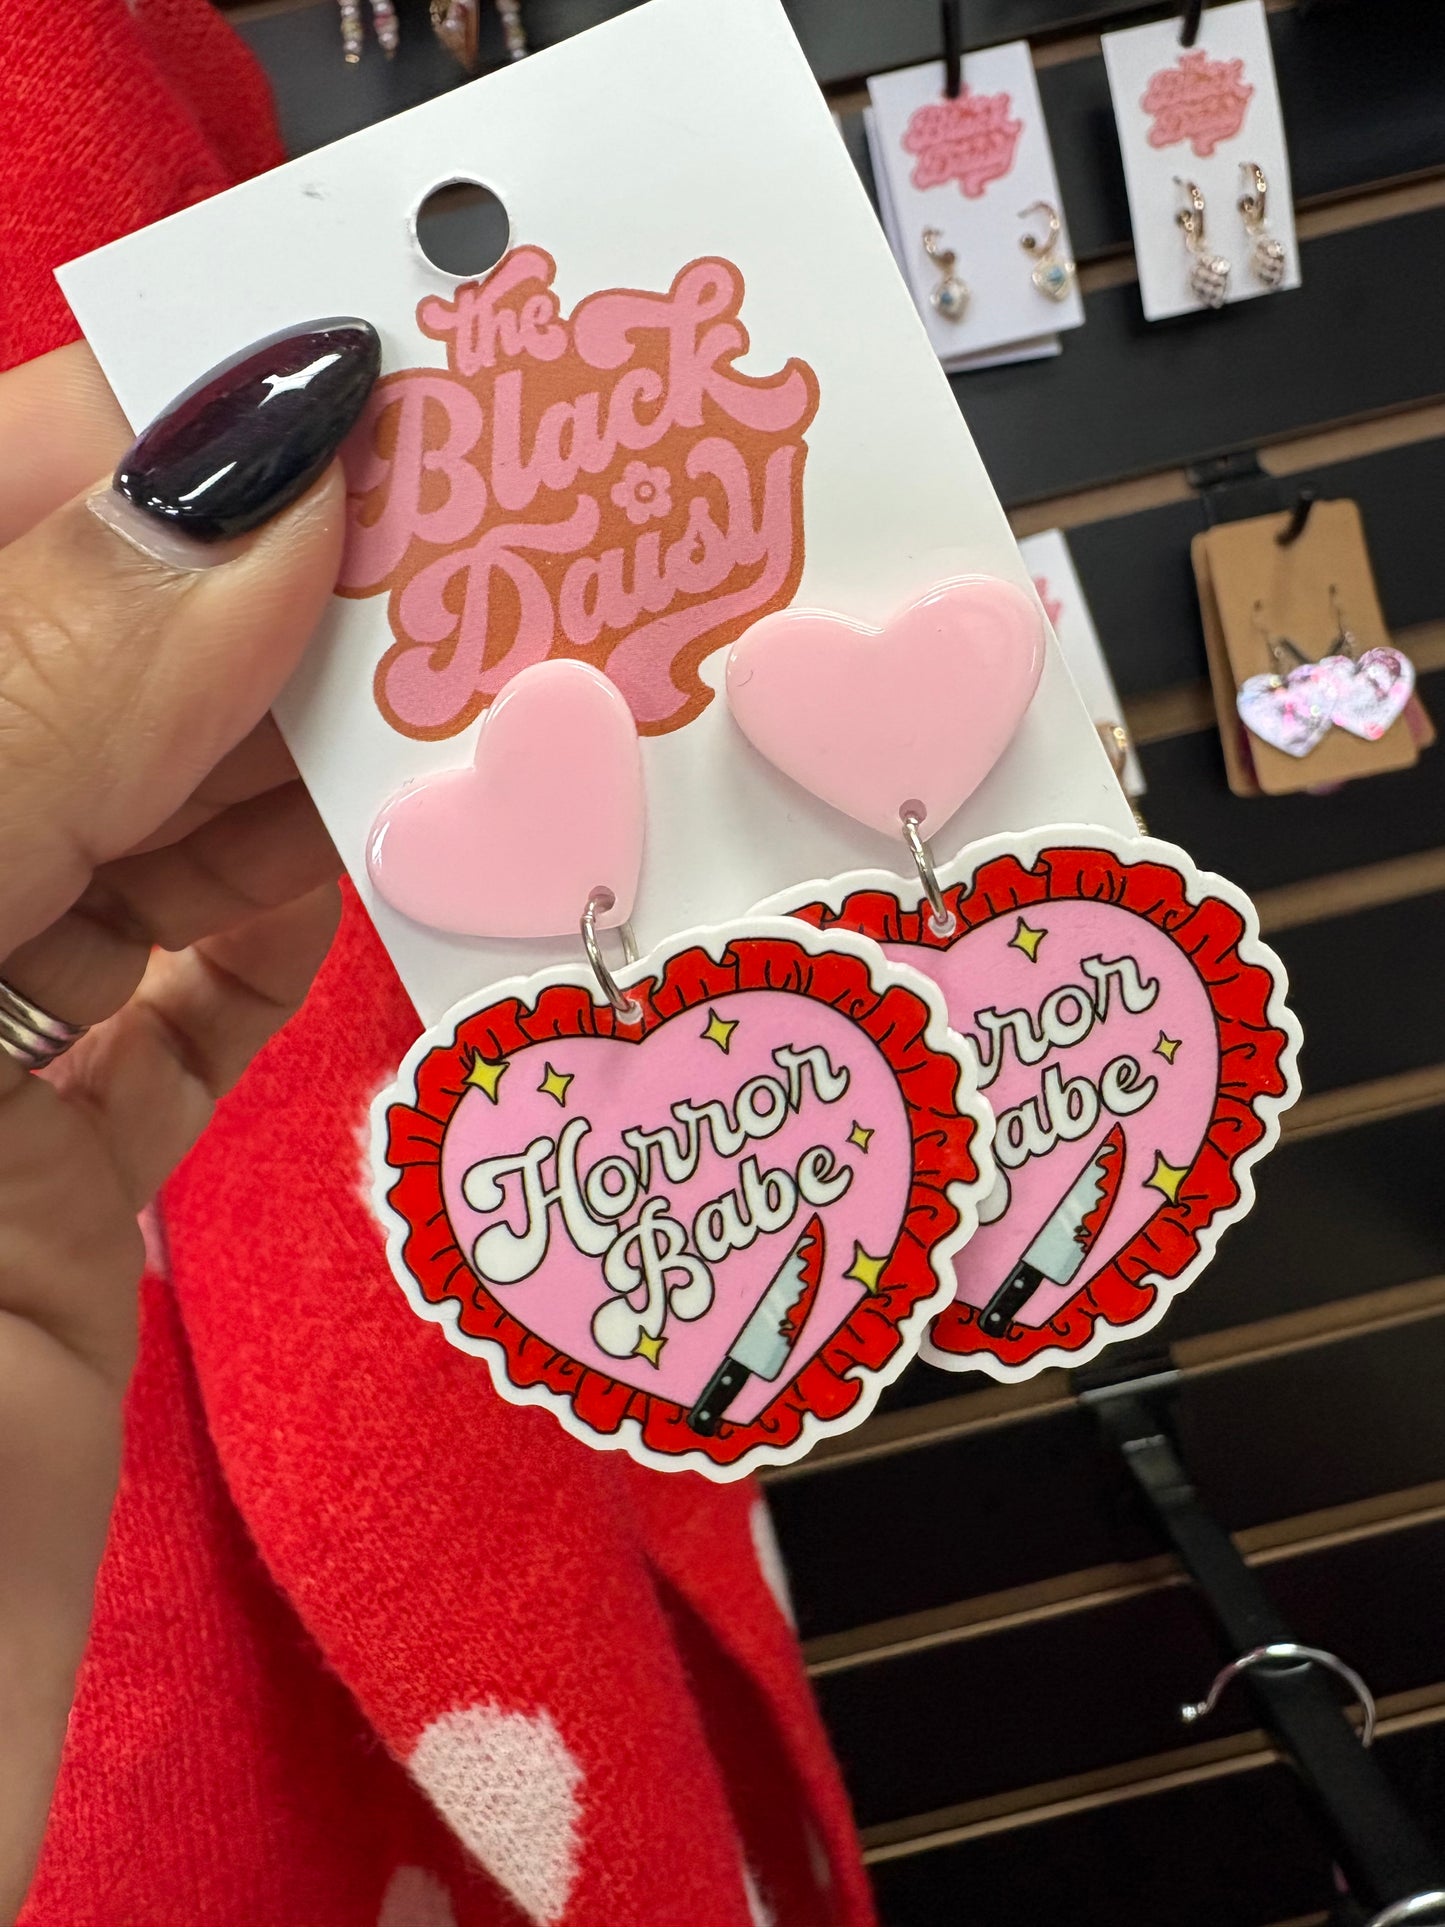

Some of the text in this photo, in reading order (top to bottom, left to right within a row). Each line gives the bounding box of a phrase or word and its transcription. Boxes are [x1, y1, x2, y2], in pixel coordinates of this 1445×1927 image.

[422, 249, 568, 375] the
[339, 262, 807, 587] Black
[385, 437, 797, 727] Daisy
[965, 954, 1159, 1090] ror
[463, 1044, 850, 1285] Horror
[978, 1054, 1158, 1225] abe
[591, 1147, 853, 1358] Babe
